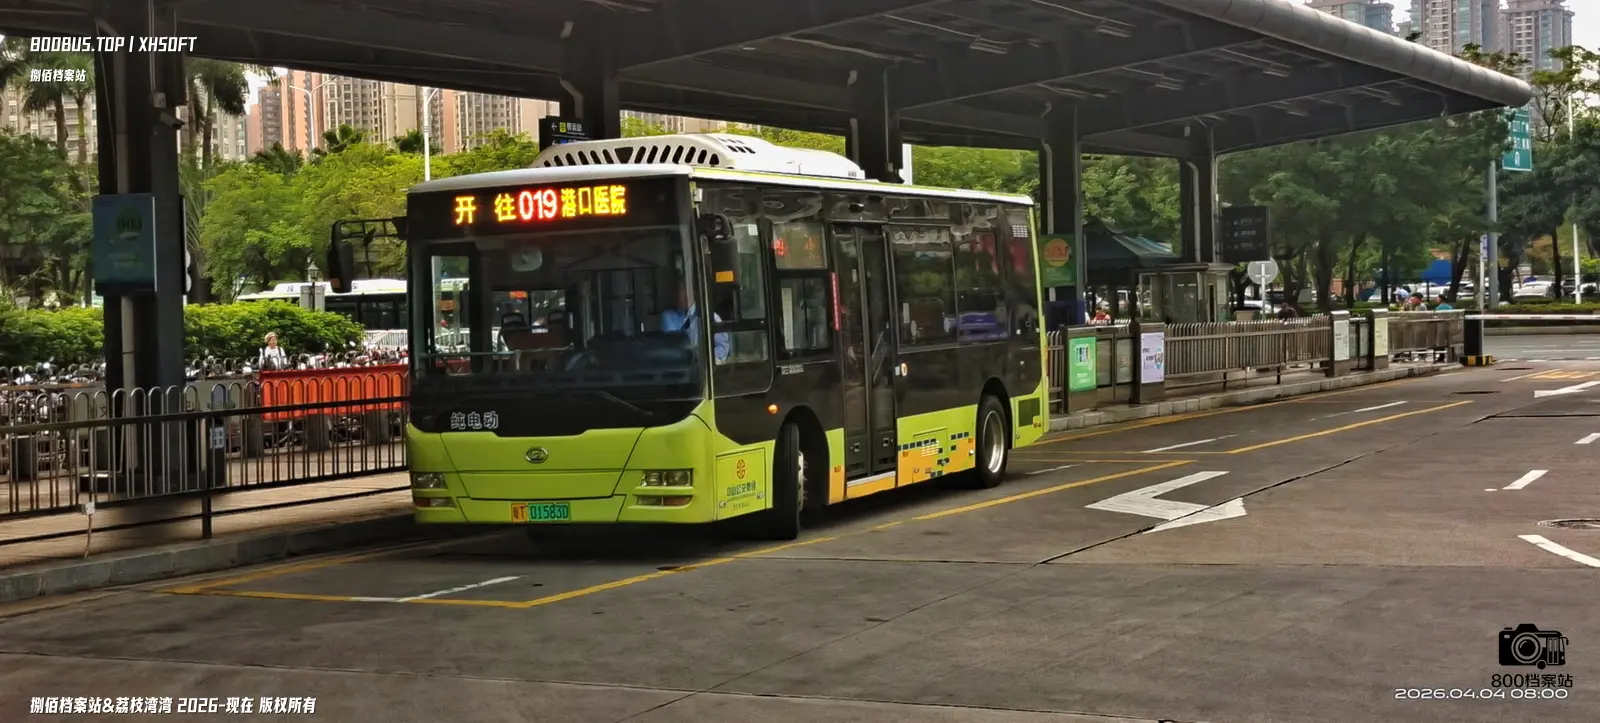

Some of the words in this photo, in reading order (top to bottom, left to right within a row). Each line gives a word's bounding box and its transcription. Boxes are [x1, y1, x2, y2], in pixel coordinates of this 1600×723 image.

[519, 191, 557, 220] 019
[561, 185, 627, 218] 港口医院
[450, 410, 499, 430] 纯电动
